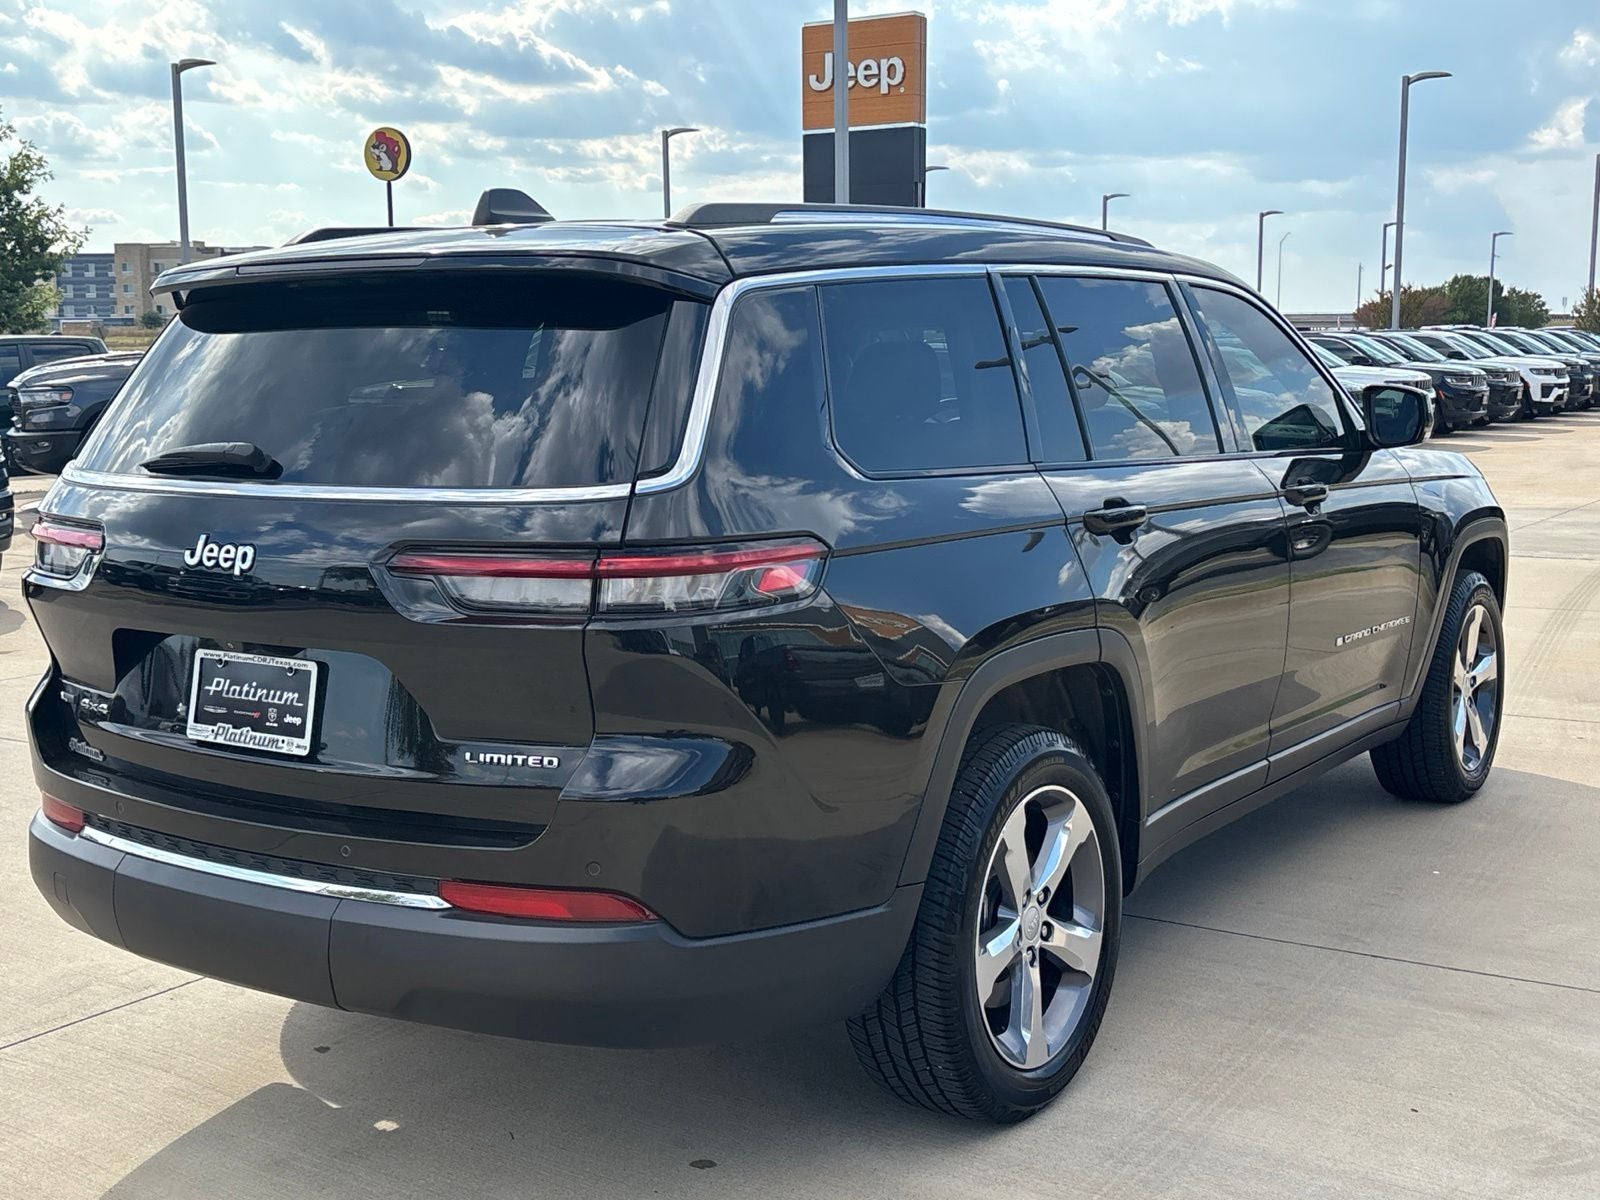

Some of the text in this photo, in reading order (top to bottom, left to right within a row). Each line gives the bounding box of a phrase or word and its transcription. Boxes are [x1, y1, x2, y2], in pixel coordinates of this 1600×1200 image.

[183, 534, 255, 576] Jeep
[1344, 616, 1411, 644] GRAND CHEROKEE
[203, 677, 304, 707] Platinum
[283, 713, 302, 726] Jeep
[213, 724, 285, 751] Platinum
[464, 751, 560, 769] LIMITED
